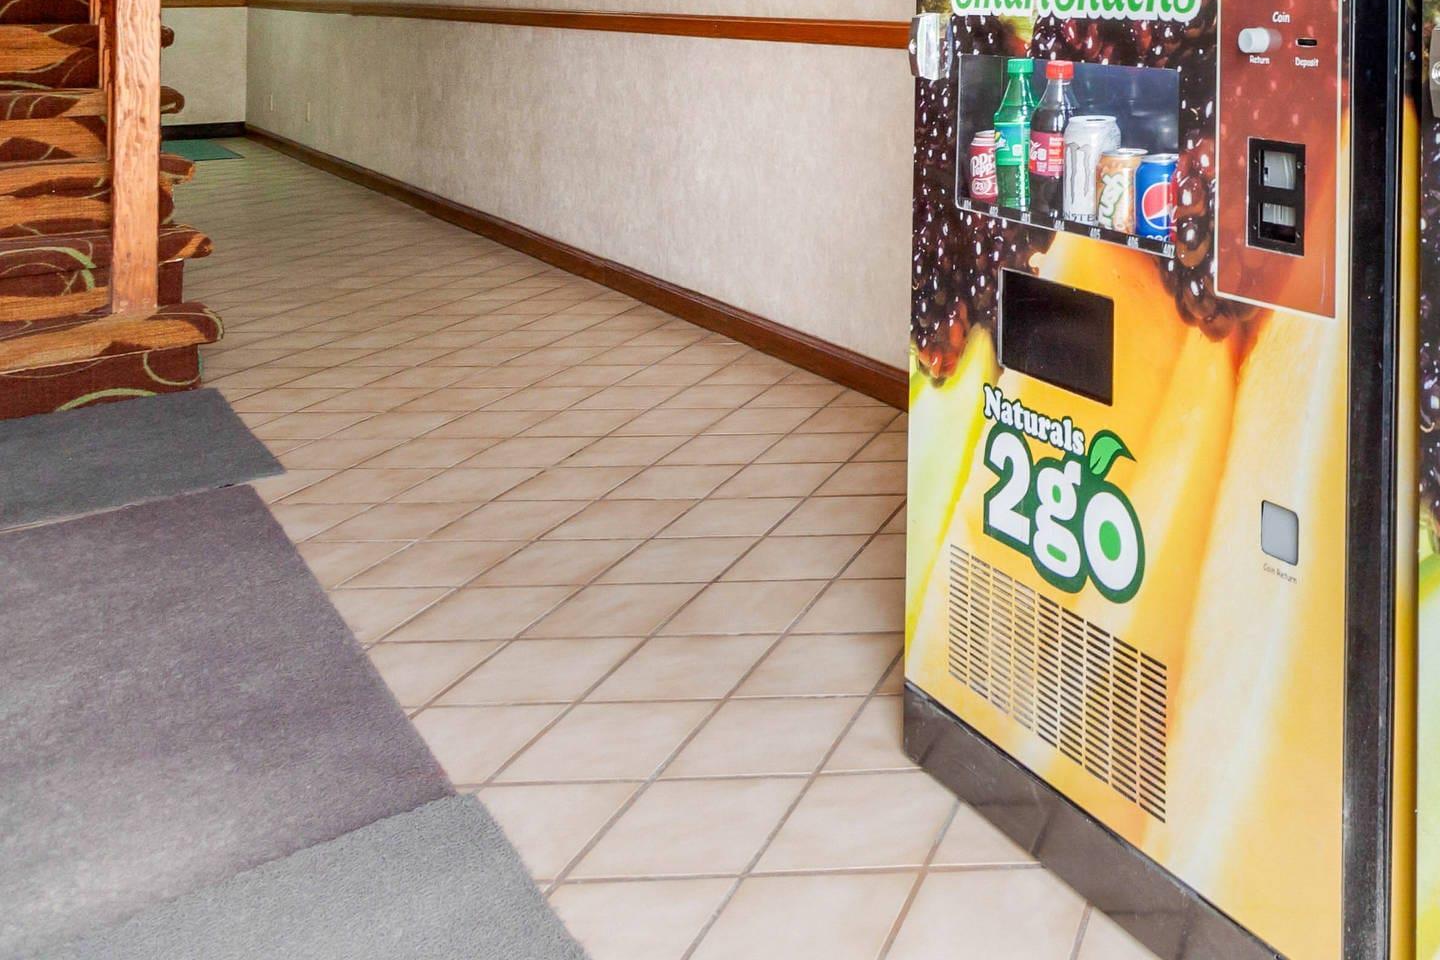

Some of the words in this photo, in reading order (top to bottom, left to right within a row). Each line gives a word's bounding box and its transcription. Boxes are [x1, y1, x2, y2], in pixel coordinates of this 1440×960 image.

[1272, 10, 1291, 24] Coin
[1249, 55, 1271, 65] Return
[1295, 57, 1319, 68] Deposit
[984, 386, 1085, 455] Naturals
[988, 431, 1139, 591] 2go
